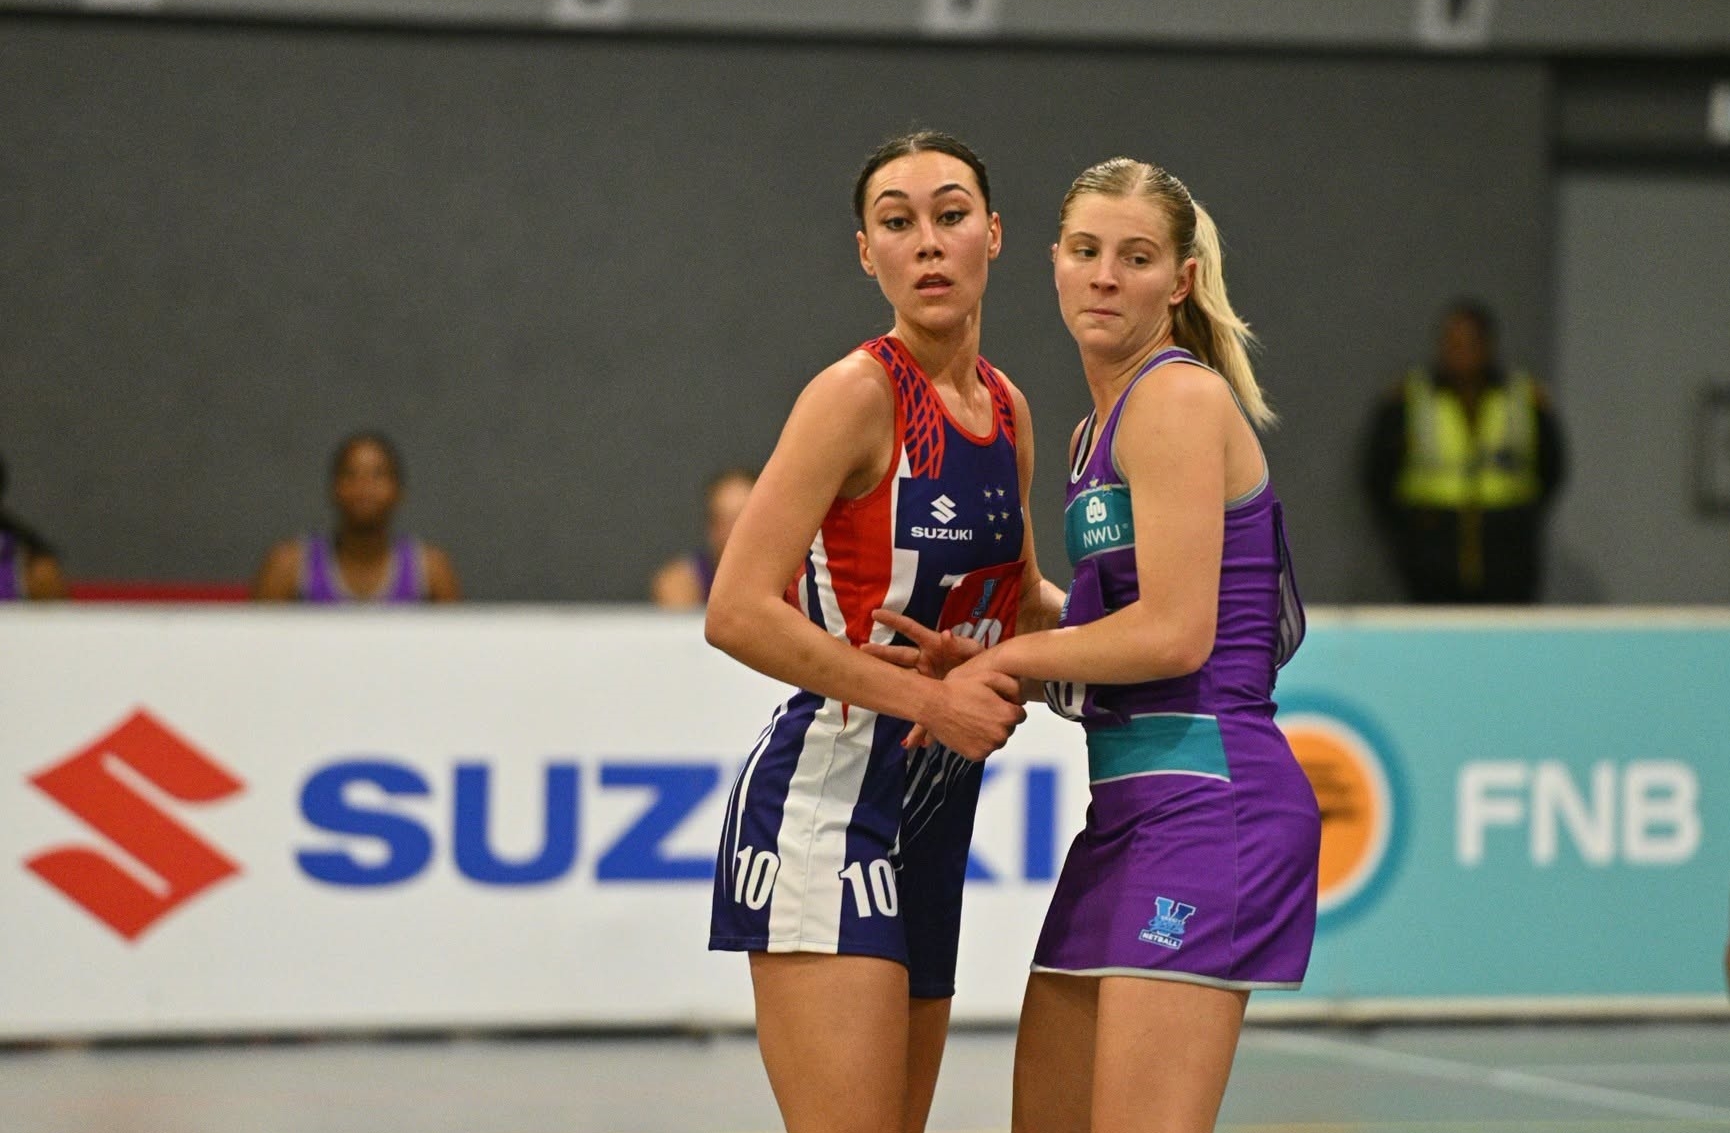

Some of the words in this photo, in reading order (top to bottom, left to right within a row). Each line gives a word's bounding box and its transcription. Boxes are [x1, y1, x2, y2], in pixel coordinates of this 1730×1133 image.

[910, 526, 973, 541] SUZUKI
[1082, 524, 1121, 549] NWU
[294, 757, 1057, 888] SUZI
[1456, 759, 1702, 867] FNB
[734, 845, 781, 911] 10
[839, 858, 899, 918] 10
[1142, 932, 1178, 947] NETBALL
